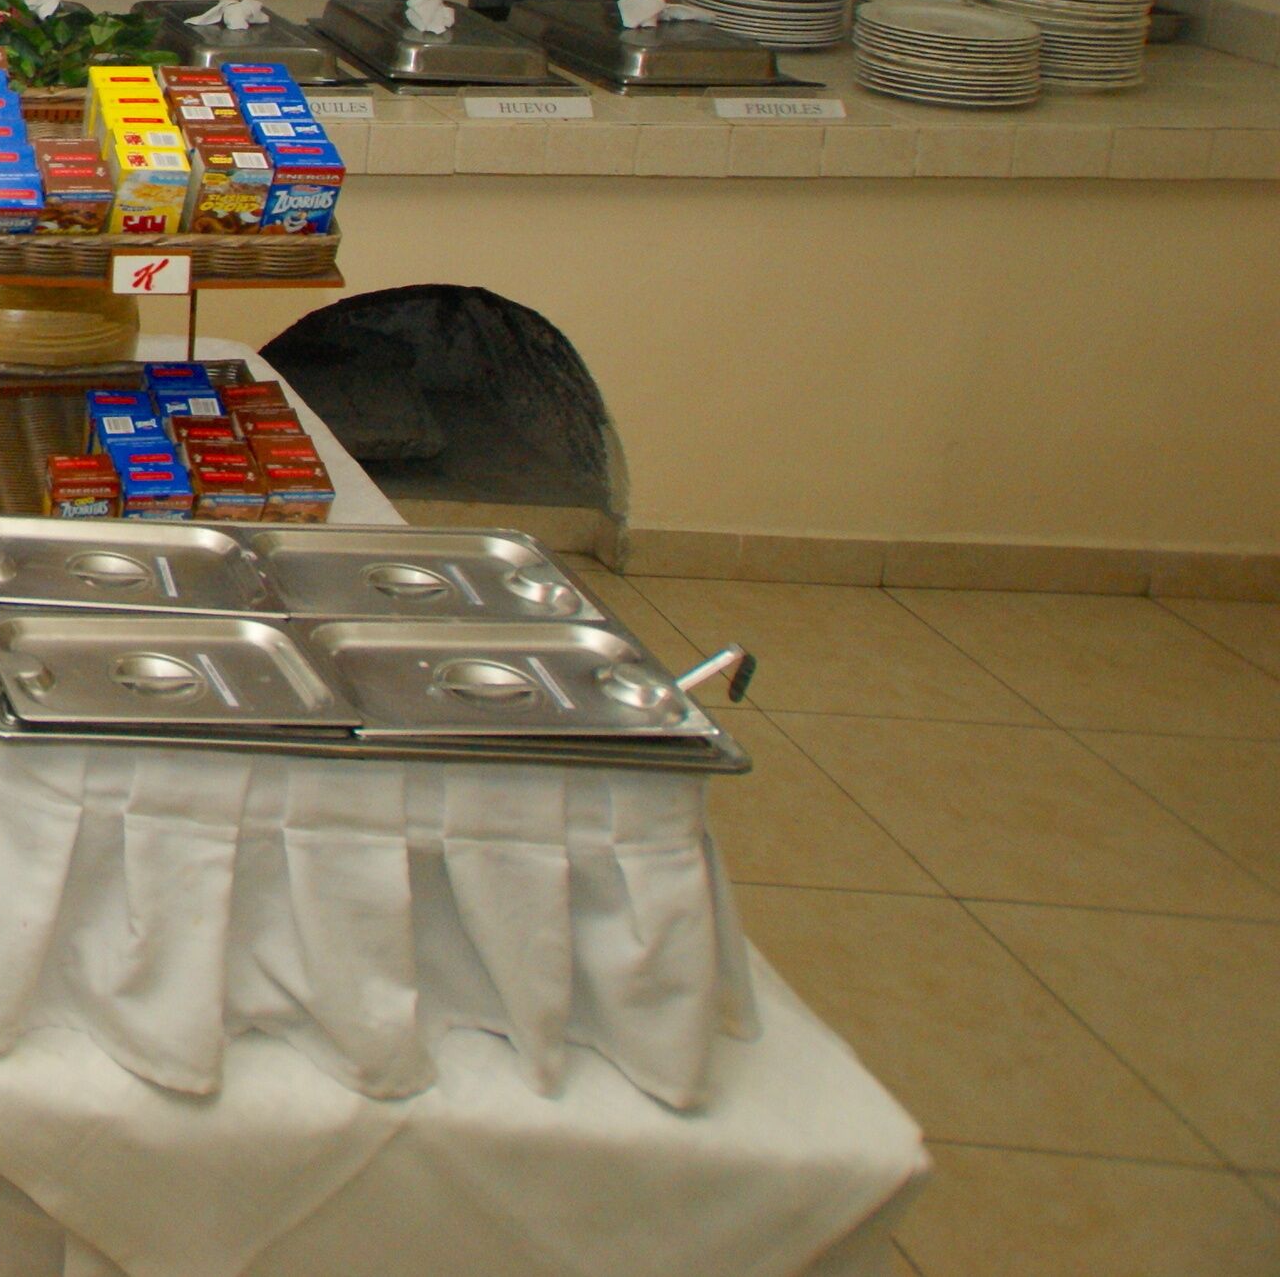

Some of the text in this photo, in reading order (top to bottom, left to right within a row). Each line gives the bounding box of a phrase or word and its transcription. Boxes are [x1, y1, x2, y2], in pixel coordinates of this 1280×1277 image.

[499, 102, 557, 114] HUEVO
[744, 103, 823, 116] FRIJOLES
[132, 258, 170, 291] K
